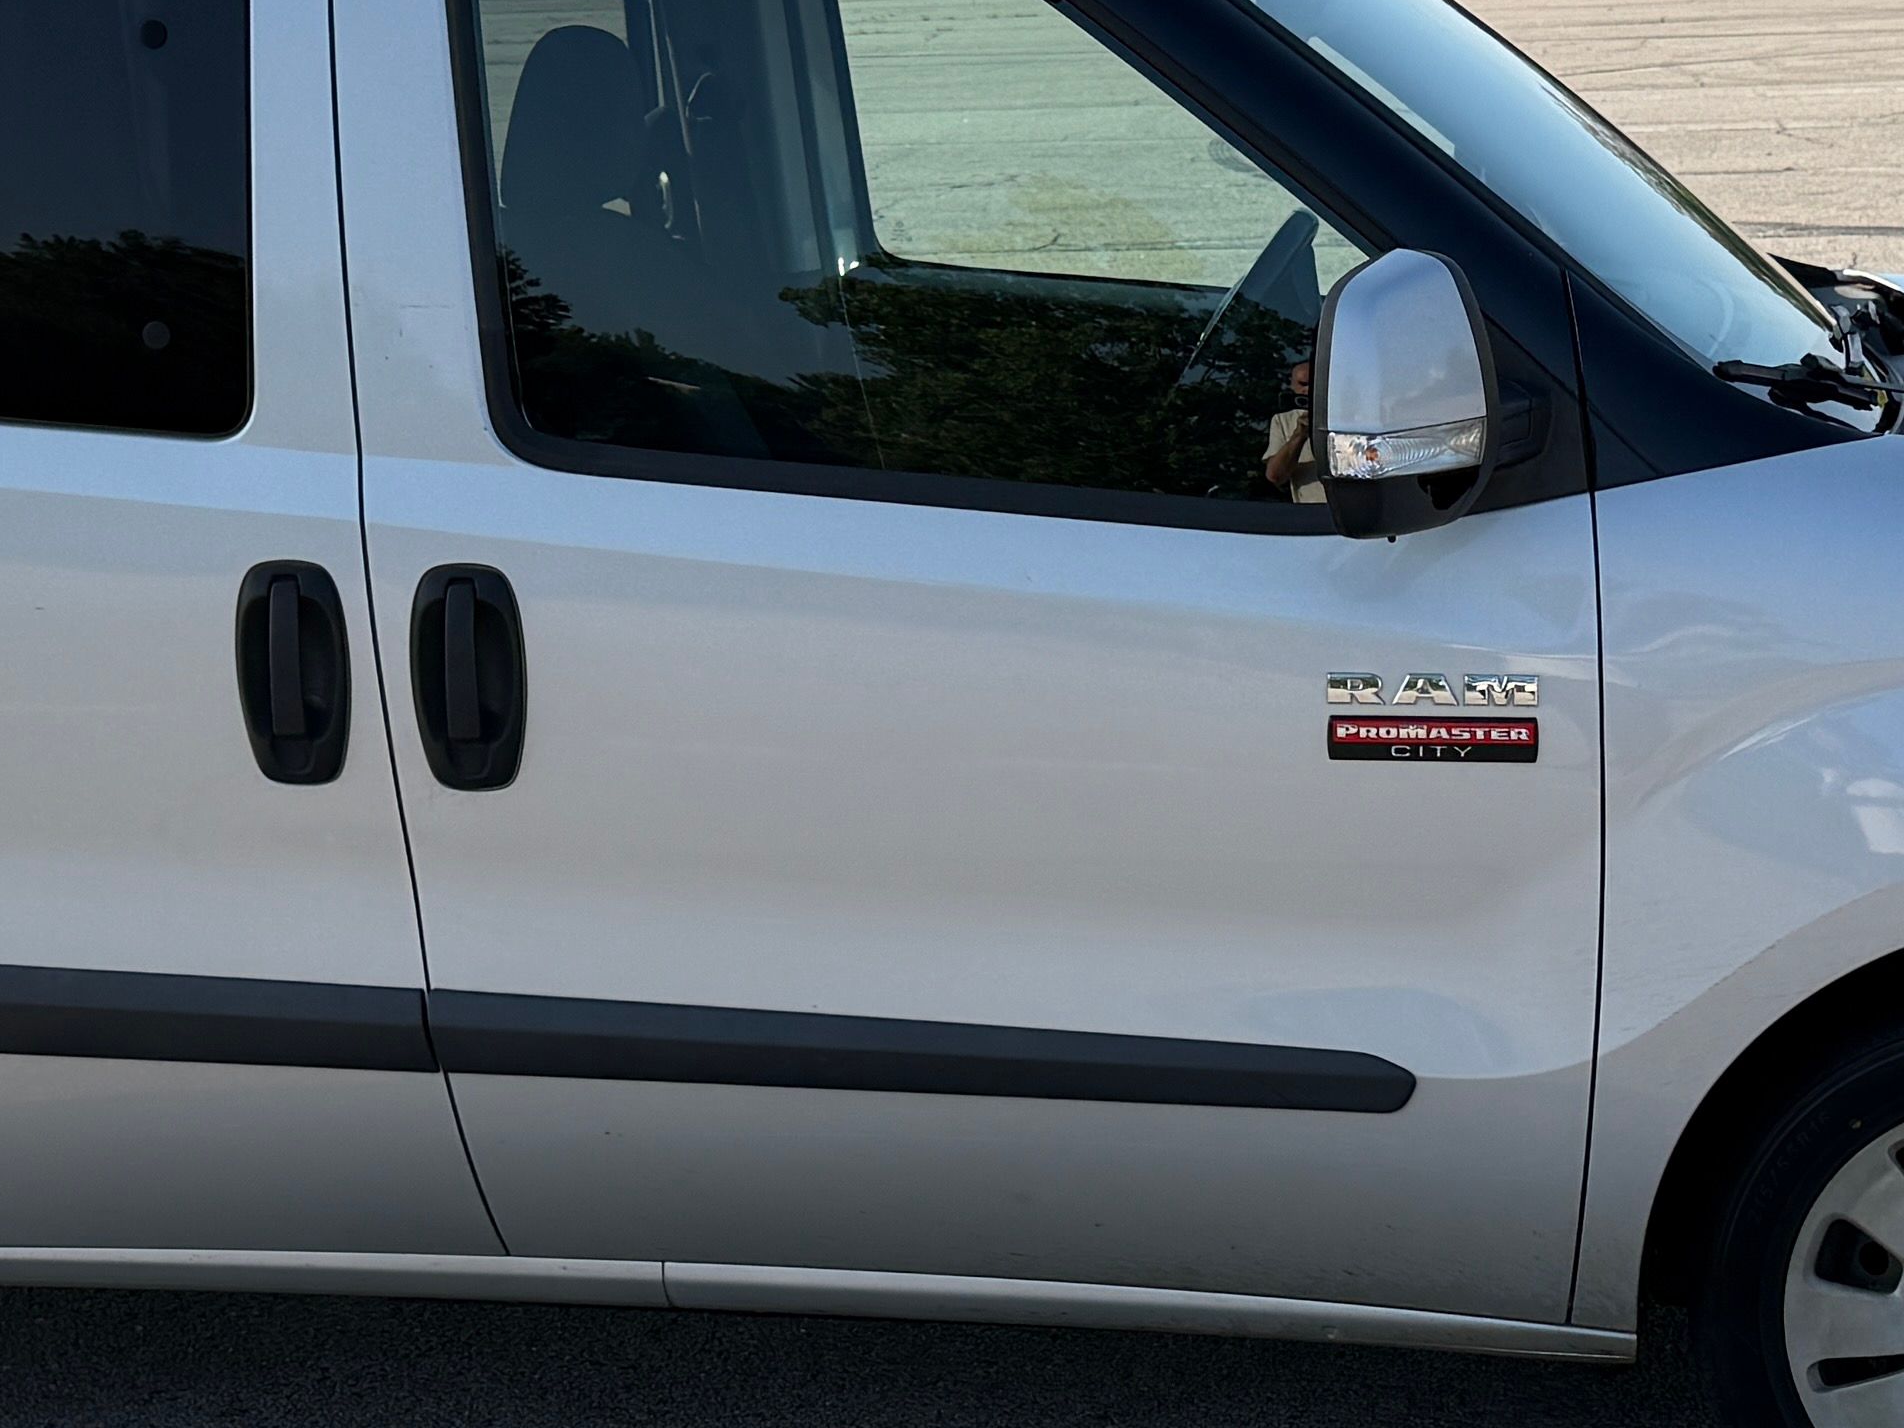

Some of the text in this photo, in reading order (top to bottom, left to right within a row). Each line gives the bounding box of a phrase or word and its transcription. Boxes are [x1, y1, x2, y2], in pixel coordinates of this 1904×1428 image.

[1327, 672, 1540, 707] RAM
[1336, 723, 1530, 741] PROMASTER
[1391, 745, 1473, 758] CITY
